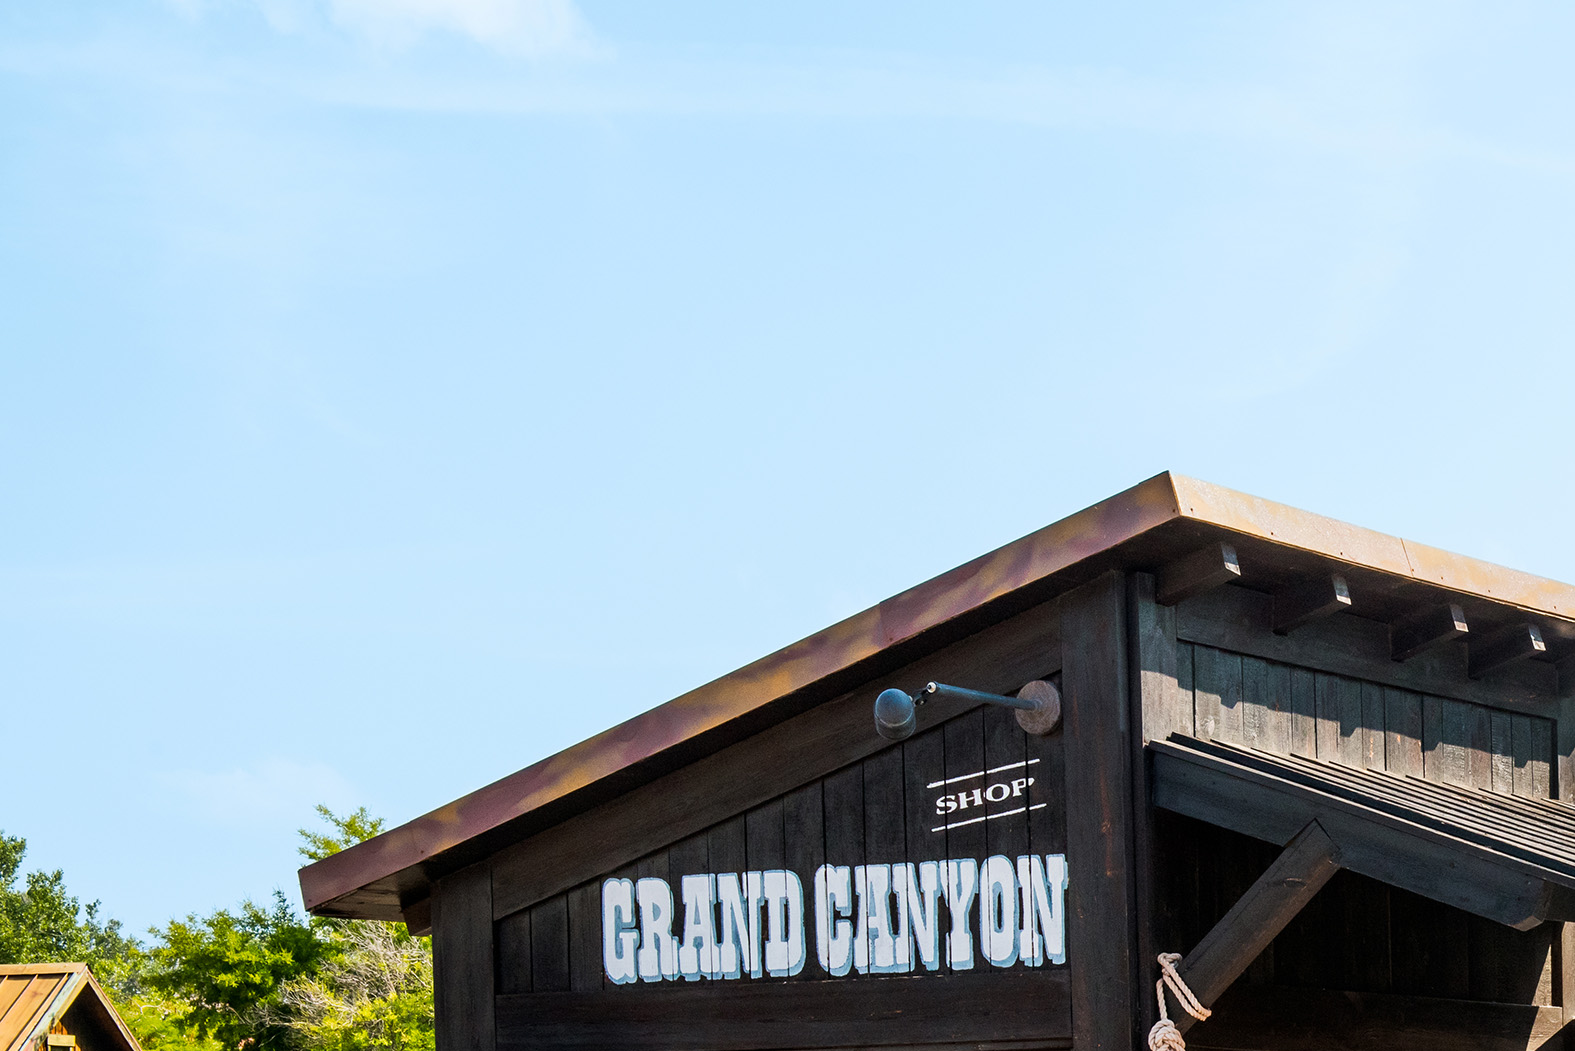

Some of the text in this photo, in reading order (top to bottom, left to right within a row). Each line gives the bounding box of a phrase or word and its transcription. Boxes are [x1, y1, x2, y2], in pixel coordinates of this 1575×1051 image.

[935, 777, 1035, 816] SHOP
[601, 853, 1069, 985] GRAND CANYON
